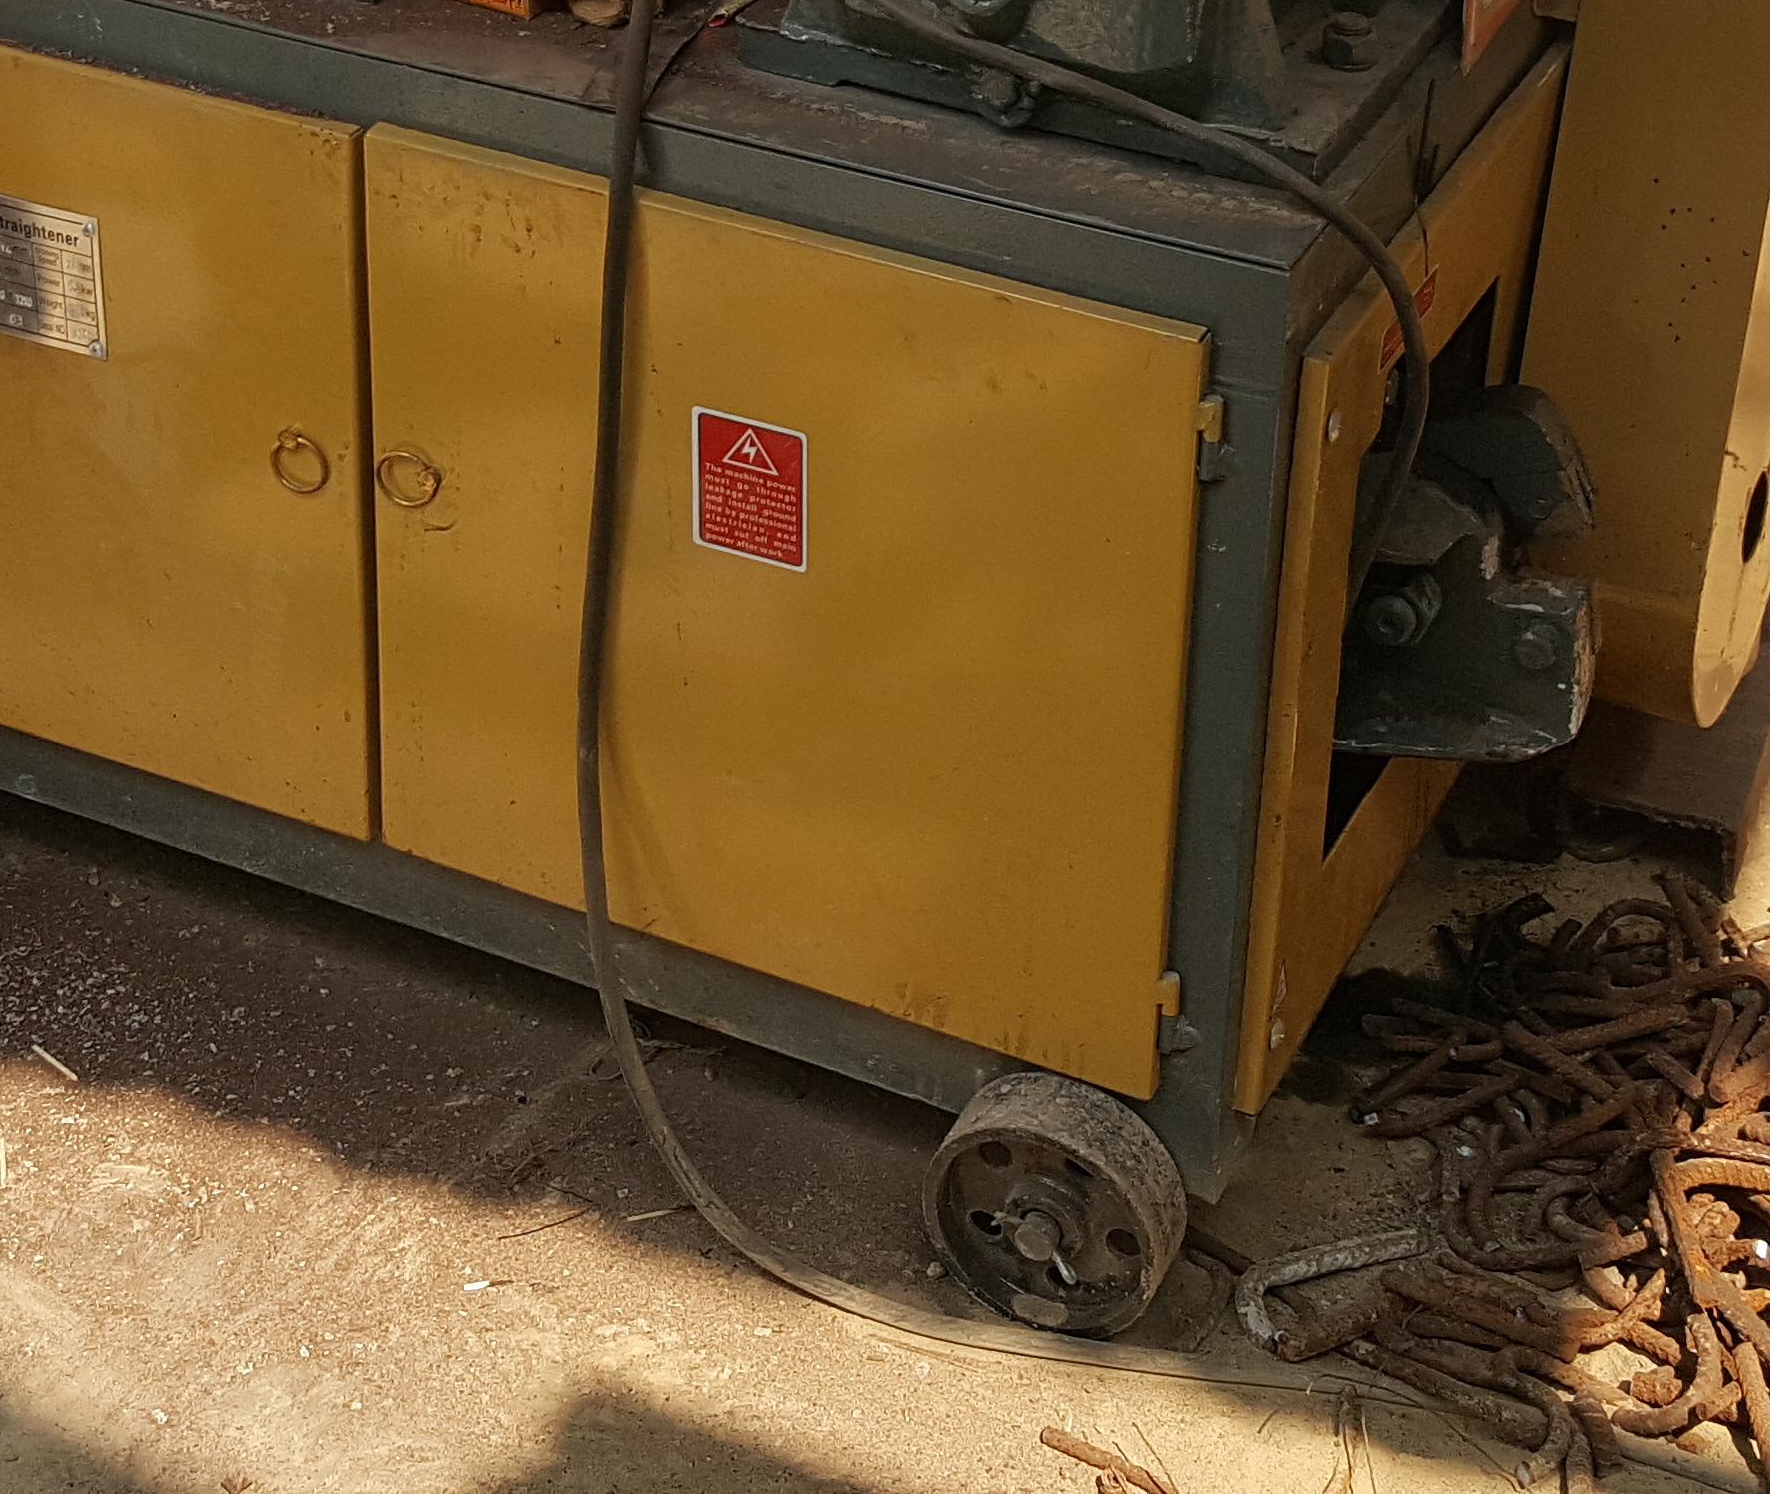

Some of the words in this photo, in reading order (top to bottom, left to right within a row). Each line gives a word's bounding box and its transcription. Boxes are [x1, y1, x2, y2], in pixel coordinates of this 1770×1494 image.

[704, 473, 730, 486] must
[736, 481, 750, 492] go
[756, 485, 797, 504] through
[705, 462, 722, 473] The
[725, 469, 764, 484] machine
[767, 479, 796, 492] power
[704, 482, 743, 499] leakage
[749, 495, 796, 512] protector
[704, 493, 723, 504] and
[728, 498, 758, 512] install
[763, 507, 797, 523] ground
[705, 502, 722, 514] line
[724, 506, 737, 518] by
[739, 511, 797, 532] professional
[704, 532, 735, 545] power
[736, 538, 758, 551] after
[705, 522, 730, 534] must
[734, 528, 749, 539] cut
[754, 533, 768, 544] off
[773, 539, 797, 552] main
[776, 531, 797, 542] and
